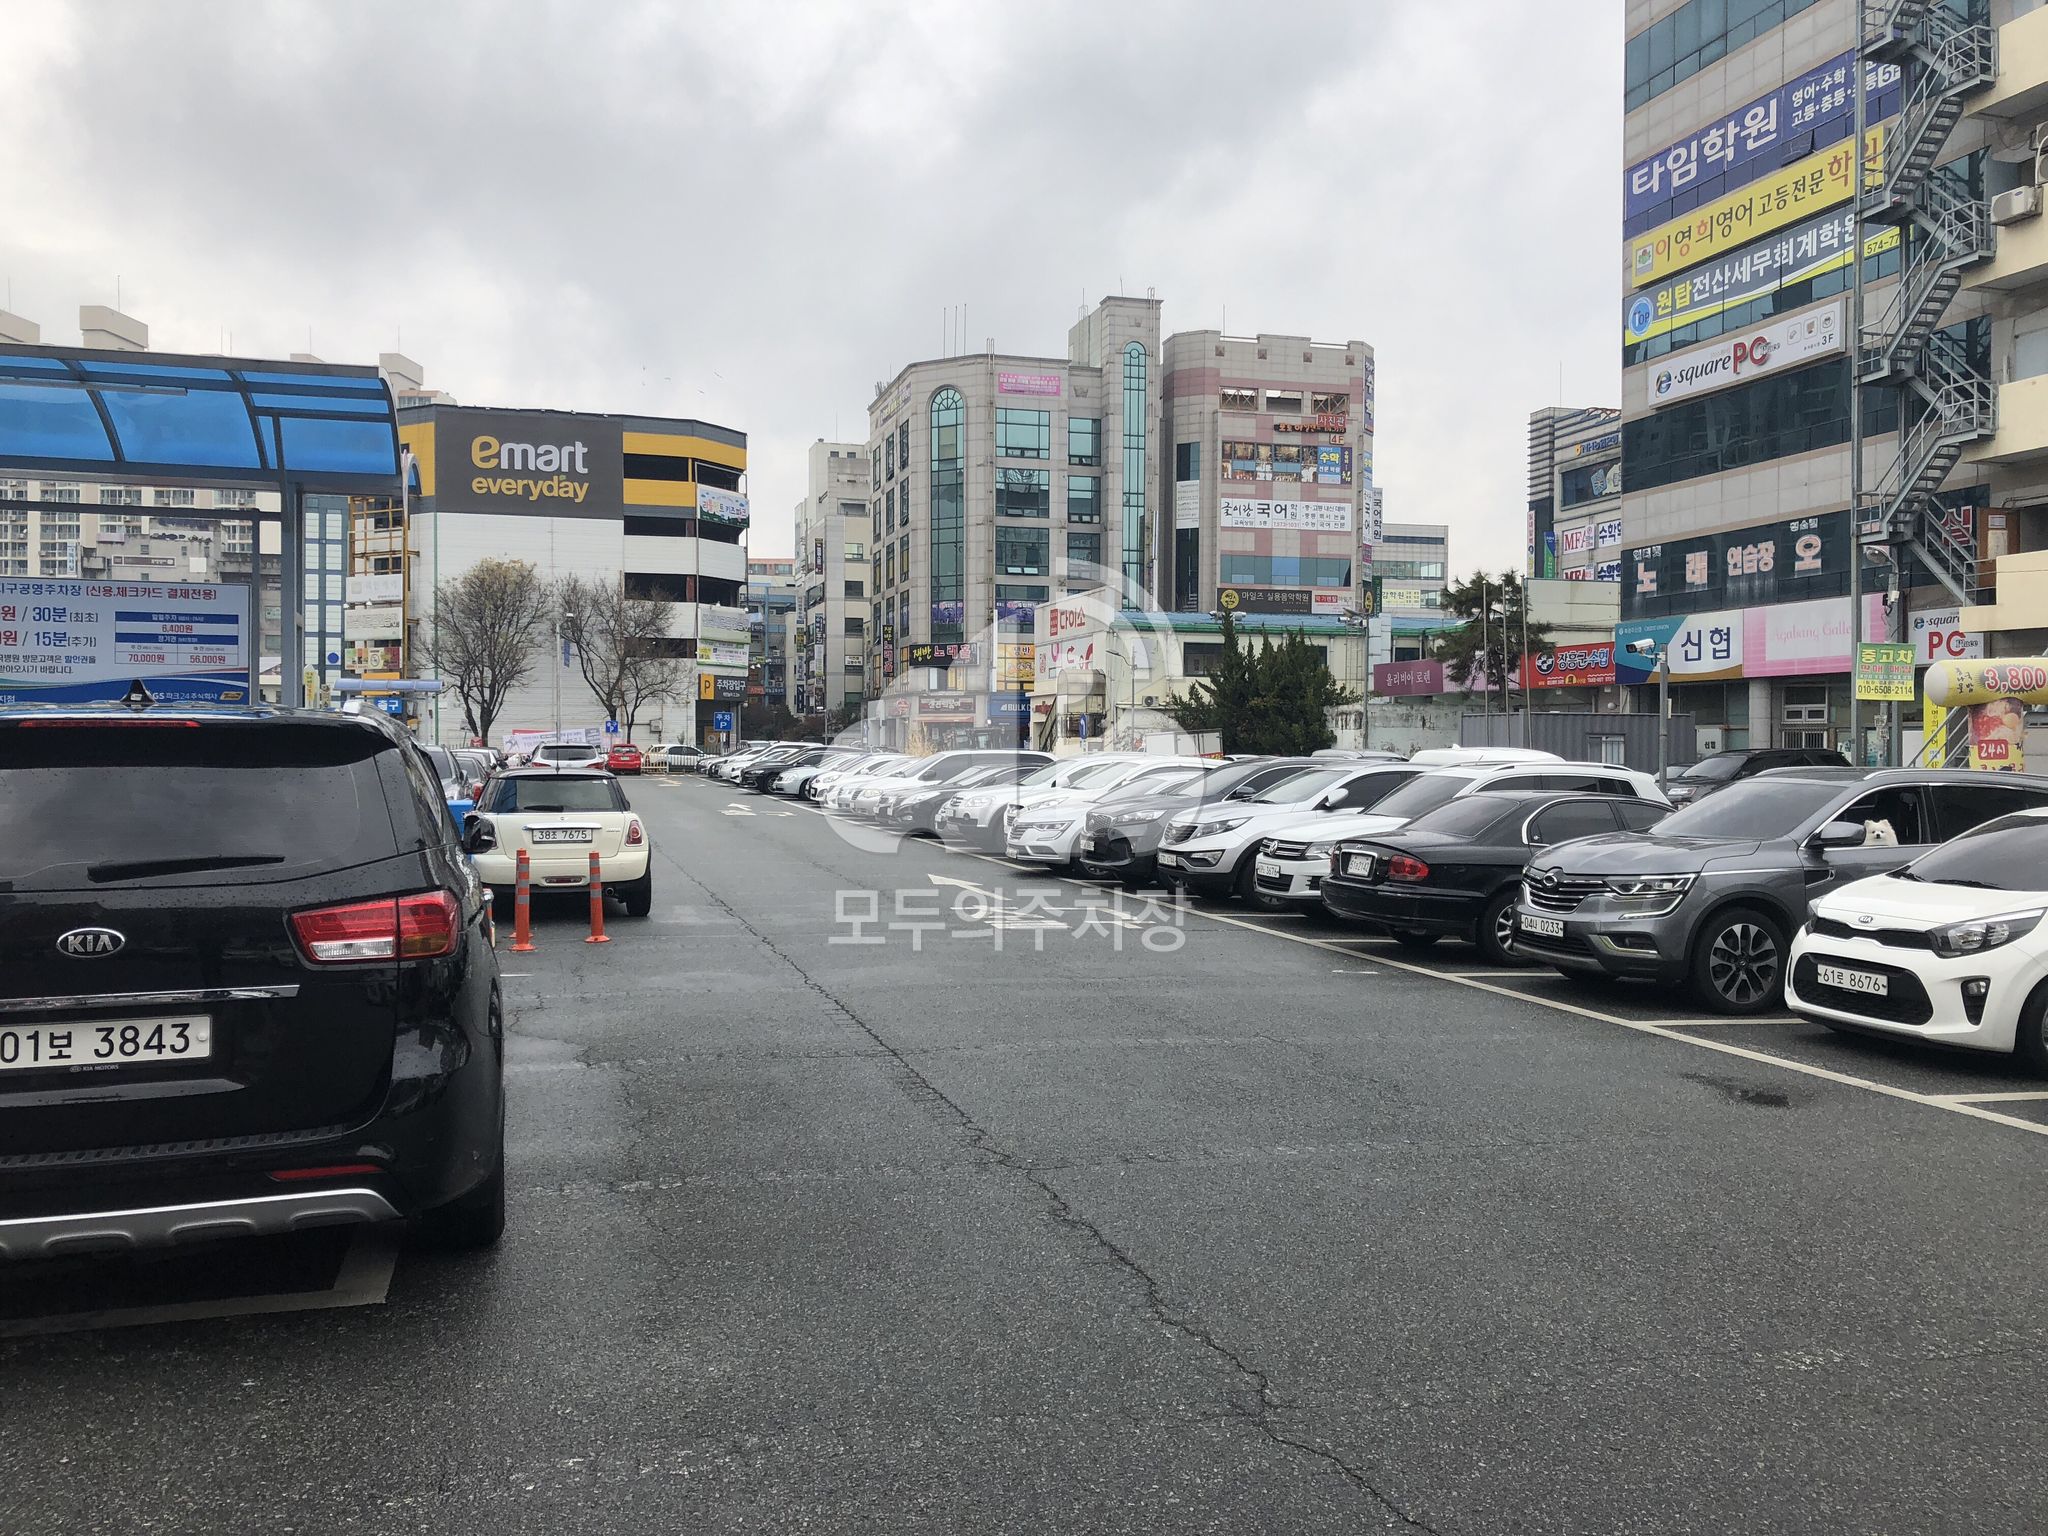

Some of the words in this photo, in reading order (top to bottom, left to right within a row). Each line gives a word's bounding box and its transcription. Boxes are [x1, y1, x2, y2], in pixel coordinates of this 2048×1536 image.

[1791, 70, 1878, 127] 고등·중등·등
[1632, 97, 1777, 196] 타임학원
[1822, 333, 1835, 346] 3F
[1733, 336, 1769, 375] PC
[1320, 415, 1345, 427] 사진관
[1331, 435, 1345, 444] 4F
[471, 435, 589, 474] emart
[1320, 452, 1340, 464] 수학
[471, 474, 590, 503] everyday
[1257, 502, 1288, 519] 국어
[1726, 540, 1775, 577] 연습장
[32, 606, 68, 623] 30분
[1060, 606, 1086, 630] 다이소
[1681, 626, 1731, 663] 신협
[1928, 631, 1967, 660] PC
[1557, 647, 1609, 671] 장흥군수협
[1861, 649, 1914, 665] 중고차
[704, 680, 711, 694] P
[716, 679, 746, 691] 주차장입구
[1386, 670, 1414, 687] 올리비아
[1985, 666, 2047, 693] 3,800
[1857, 684, 1913, 695] 010-6508-2114
[1007, 703, 1026, 712] BULK
[716, 713, 731, 721] 주차
[720, 721, 728, 729] P
[1980, 742, 2006, 758] 24시
[561, 829, 588, 840] 7675
[1540, 919, 1560, 935] 0233
[67, 934, 114, 953] KIA
[1823, 968, 1844, 985] 61로
[1849, 972, 1881, 992] 8676
[0, 1029, 73, 1064] 01보
[93, 1022, 191, 1059] 3843
